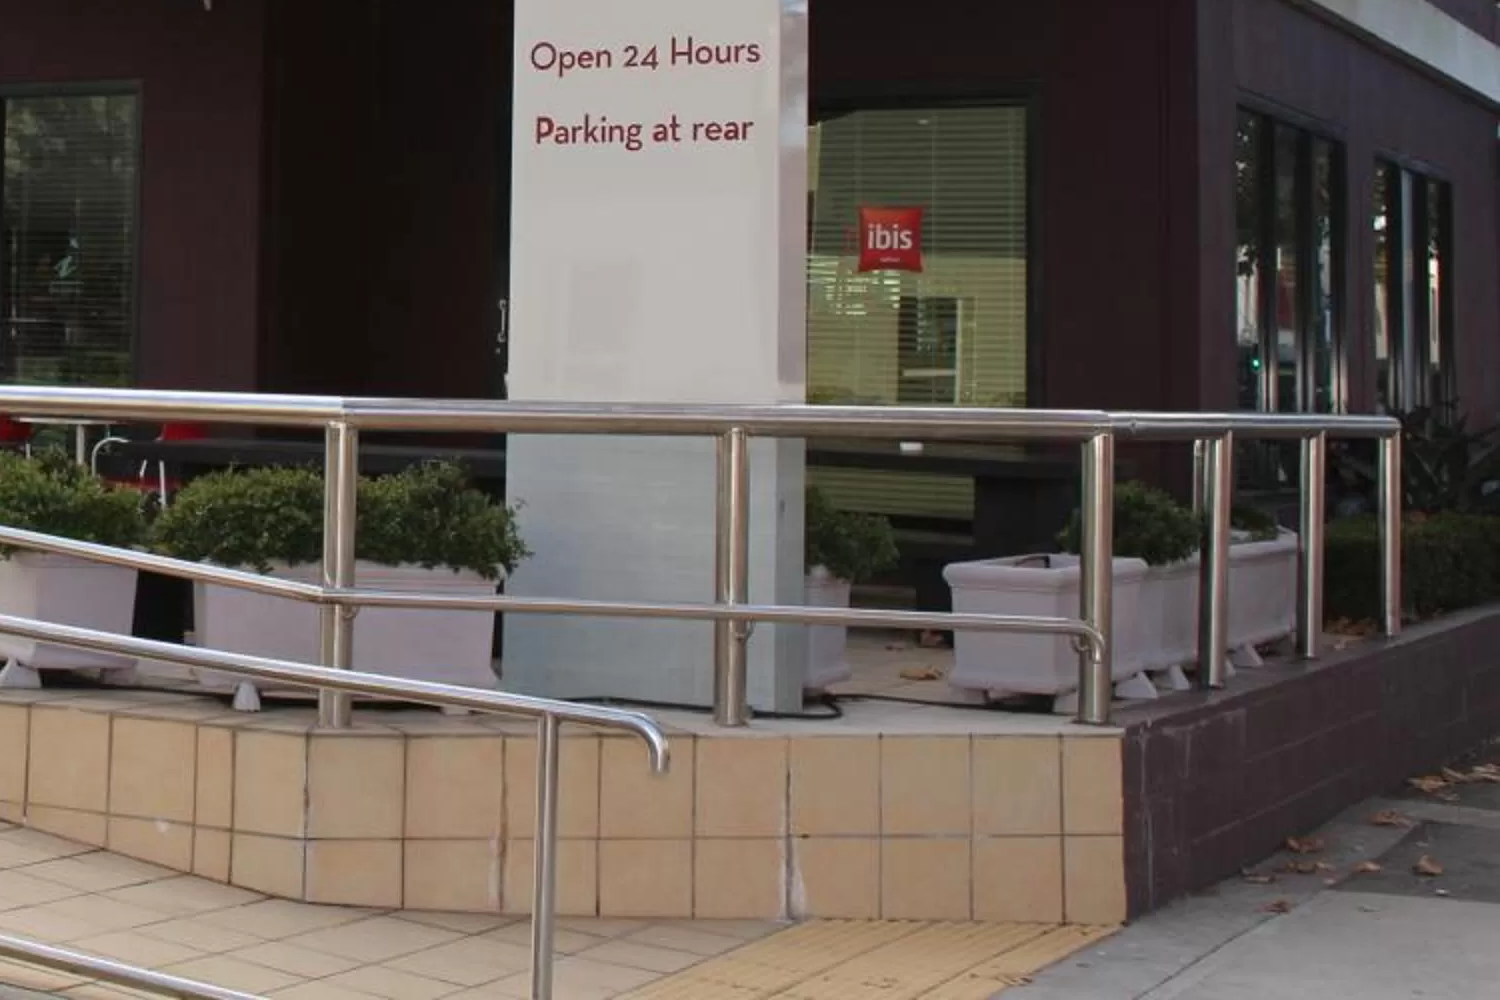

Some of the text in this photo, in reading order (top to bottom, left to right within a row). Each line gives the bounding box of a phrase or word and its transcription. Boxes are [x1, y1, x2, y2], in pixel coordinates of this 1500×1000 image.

[531, 35, 761, 78] Open 24 Hours
[536, 113, 754, 151] Parking at rear
[867, 222, 913, 250] ibis
